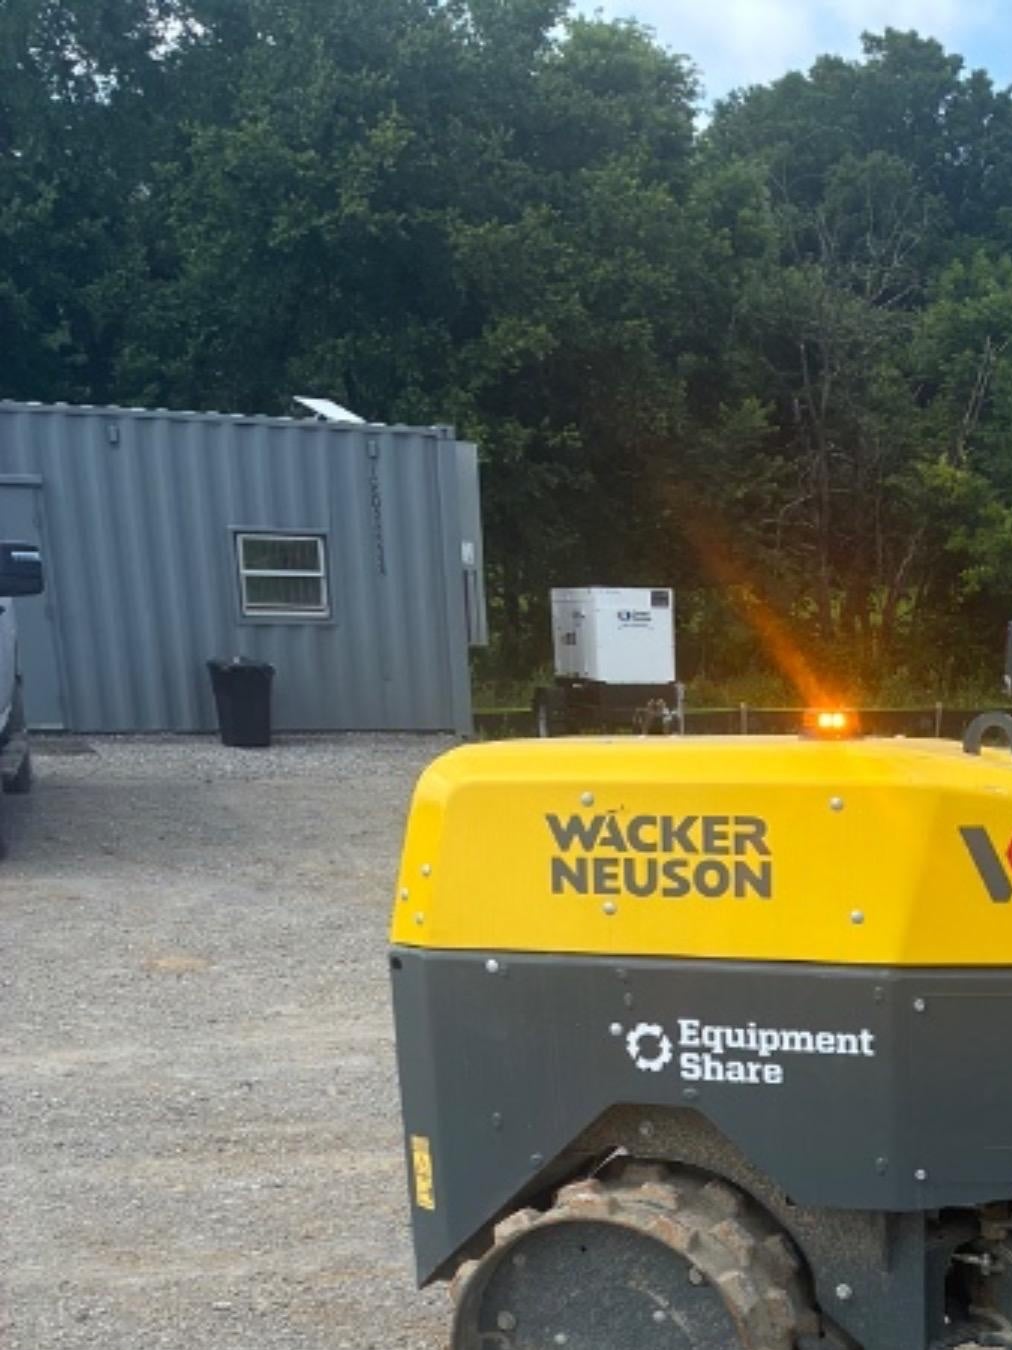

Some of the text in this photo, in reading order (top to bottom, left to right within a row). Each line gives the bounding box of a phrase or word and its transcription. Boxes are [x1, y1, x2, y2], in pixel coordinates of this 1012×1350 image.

[545, 813, 771, 855] WACKER
[551, 857, 772, 898] NEUSON
[677, 1018, 875, 1057] Equipment
[679, 1052, 784, 1084] Share
